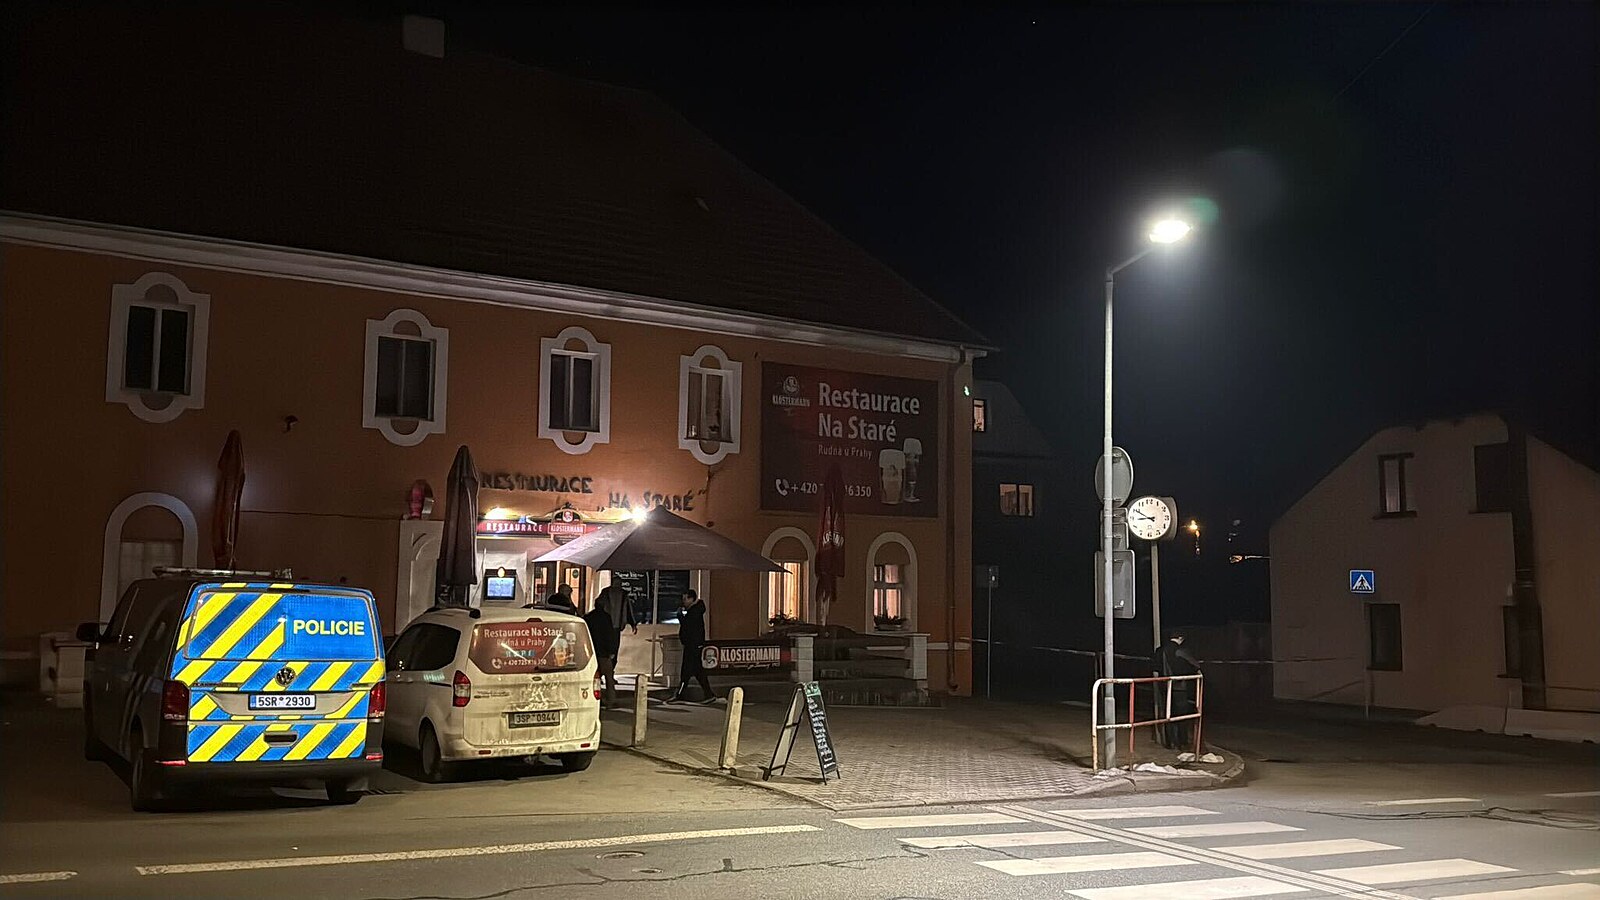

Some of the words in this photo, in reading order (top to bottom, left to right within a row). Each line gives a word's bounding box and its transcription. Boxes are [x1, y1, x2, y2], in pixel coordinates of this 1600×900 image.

[772, 394, 811, 407] KLOSTERMANN
[818, 382, 920, 415] Restaurace
[818, 412, 843, 438] Na
[847, 415, 897, 443] Staré
[851, 446, 873, 460] Prahy
[800, 481, 818, 494] 420
[855, 485, 872, 498] 350
[486, 522, 543, 532] RESTAURACE
[550, 523, 584, 533] KLOSTERMANN
[293, 619, 365, 636] POLICIE
[484, 628, 530, 638] Restaurace
[531, 627, 542, 637] Na
[527, 637, 546, 648] Prahy
[720, 647, 781, 662] KLOSTERMANN
[258, 696, 278, 707] 5SR
[285, 696, 311, 707] 2930
[516, 714, 531, 723] 3SP
[537, 713, 556, 722] 0944
